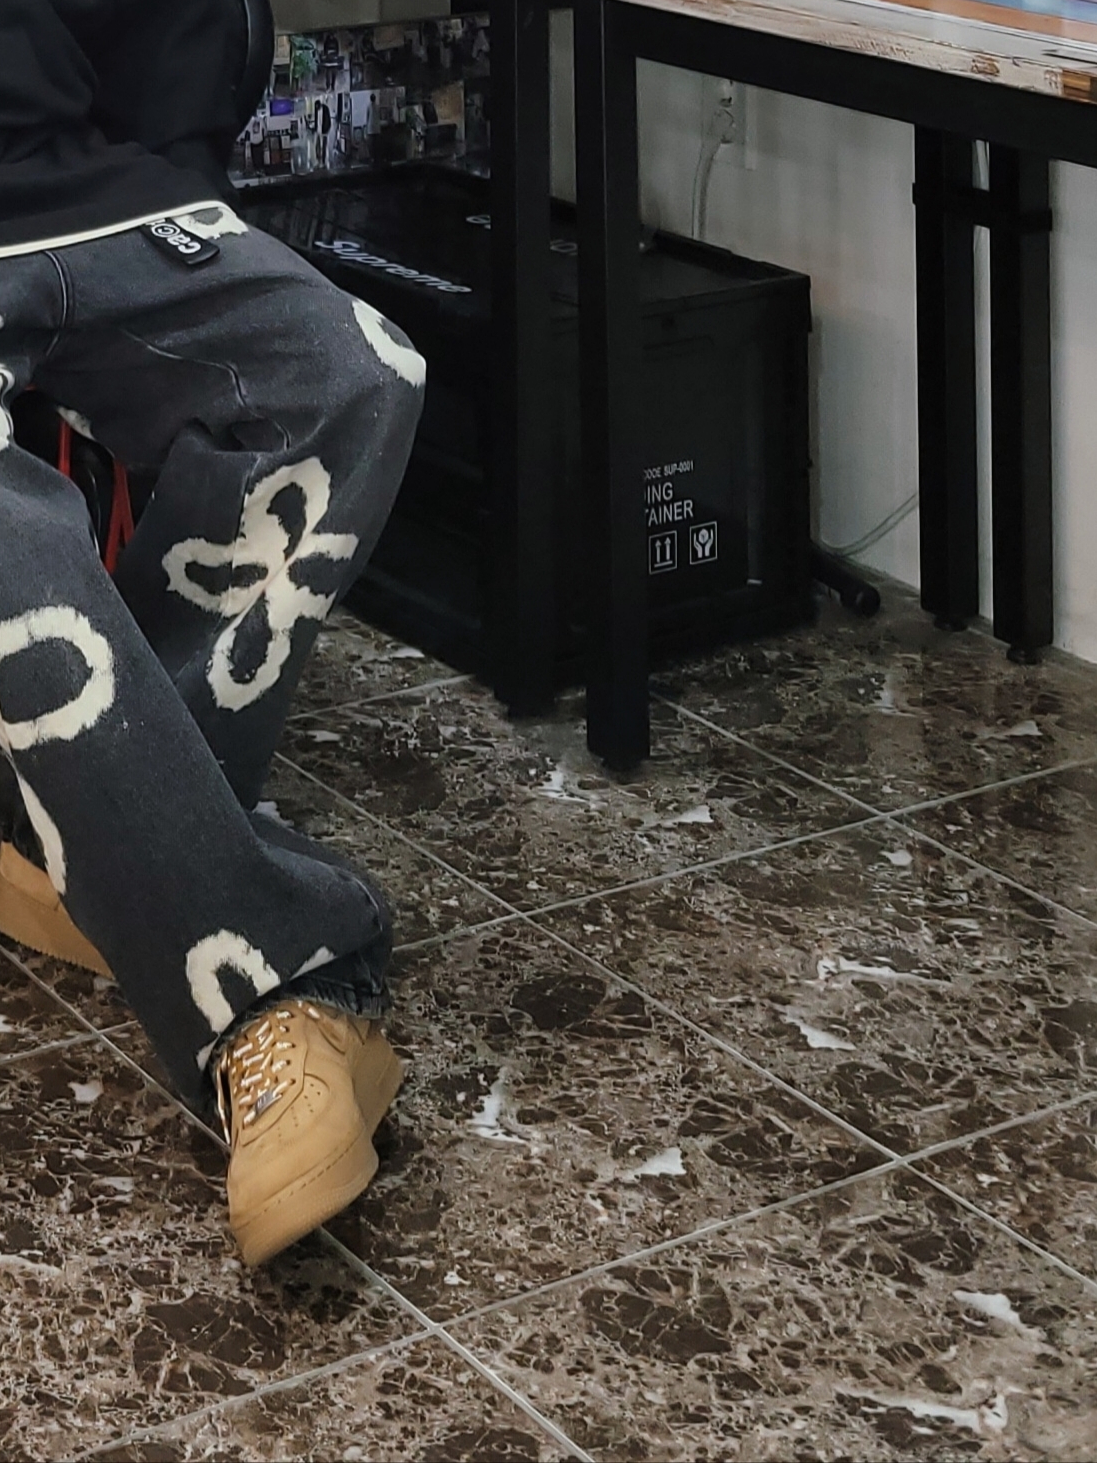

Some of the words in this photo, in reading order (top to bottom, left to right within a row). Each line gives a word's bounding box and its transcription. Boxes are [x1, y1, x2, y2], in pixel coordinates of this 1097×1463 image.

[314, 240, 472, 293] Supreme
[664, 460, 694, 477] SUP-0001
[644, 481, 674, 505] ING
